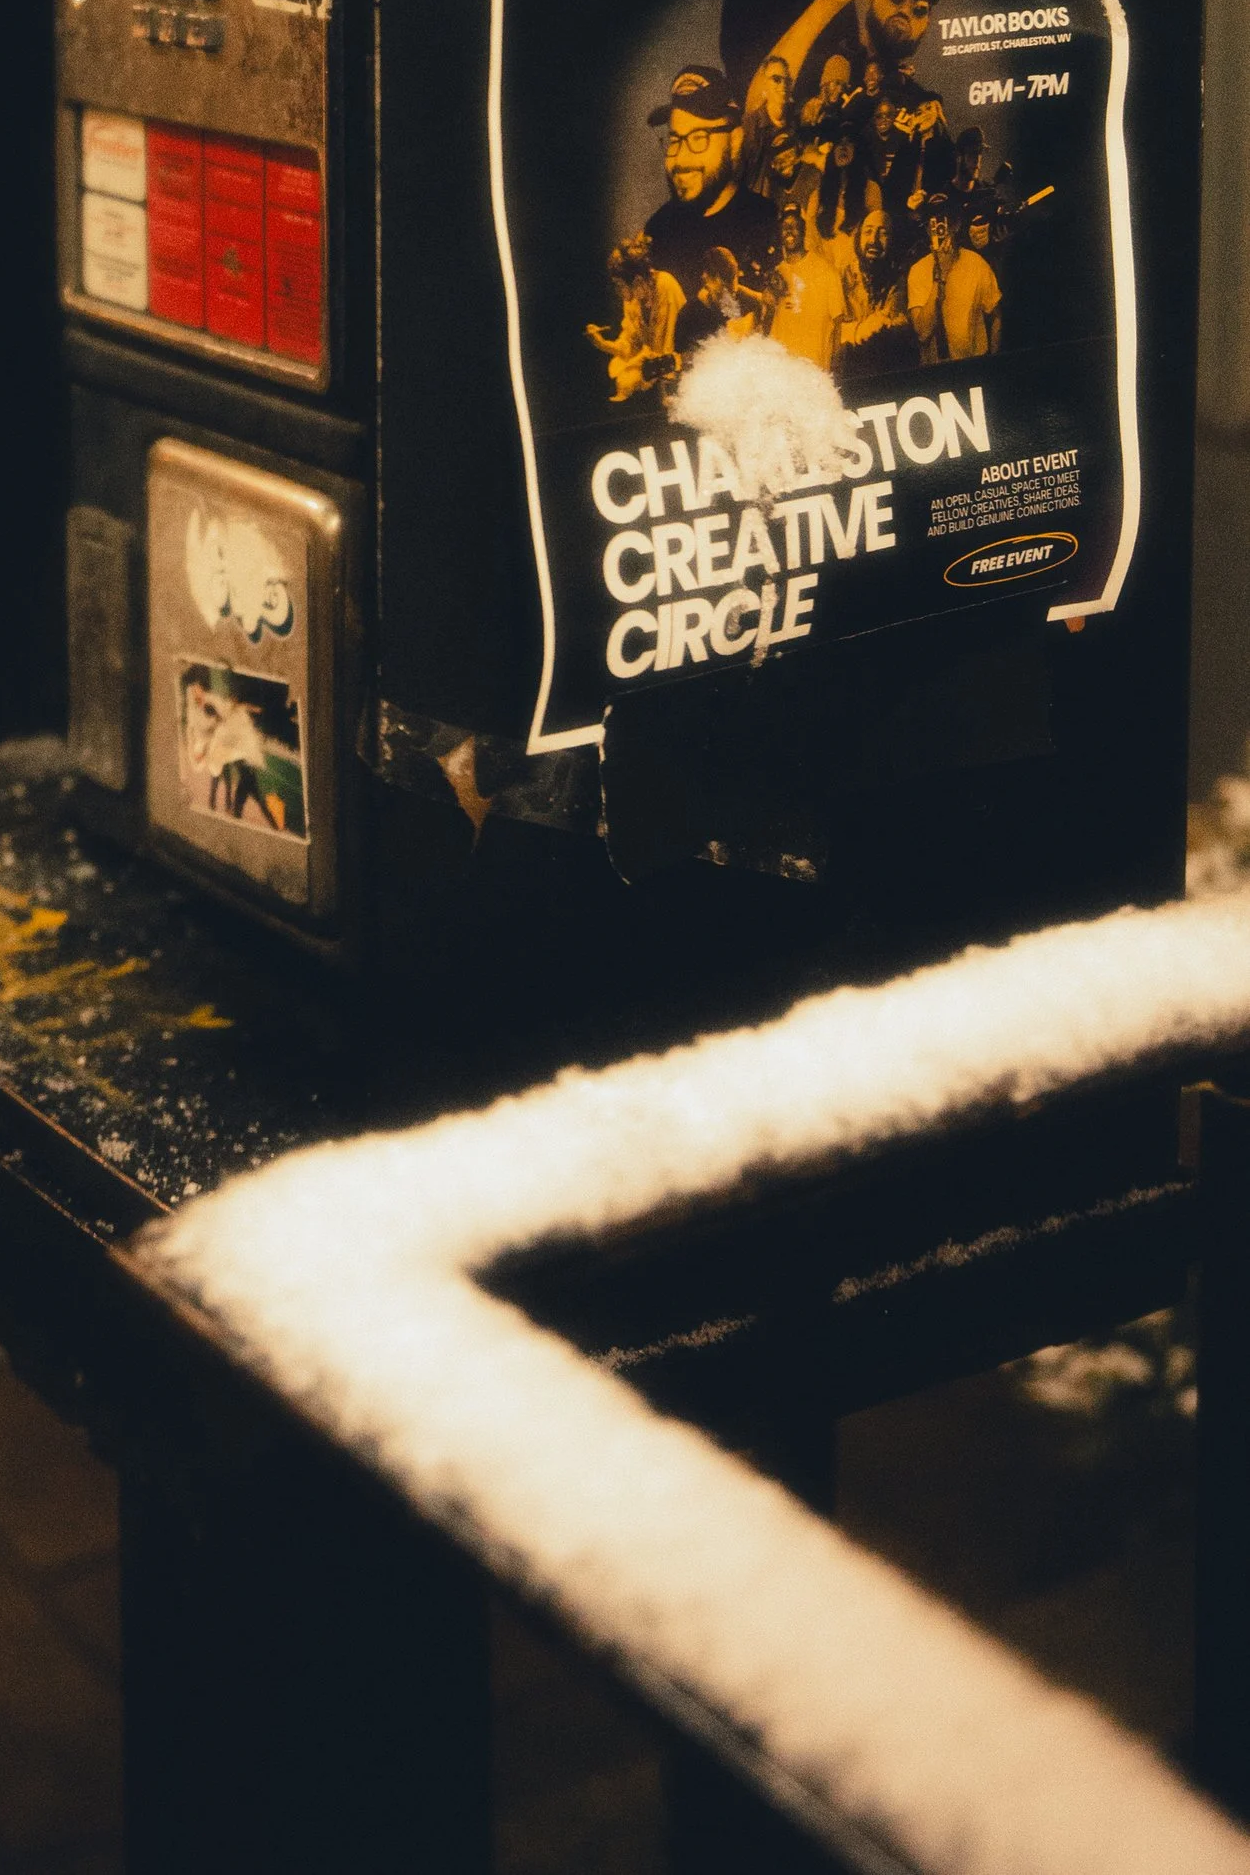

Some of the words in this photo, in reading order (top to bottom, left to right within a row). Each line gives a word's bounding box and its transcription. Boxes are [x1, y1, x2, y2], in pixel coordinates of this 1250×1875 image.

[938, 15, 1007, 40] TAYLOR
[1008, 6, 1071, 32] BOOKS
[957, 42, 990, 55] CAPITOL
[990, 40, 1002, 51] ST,
[1003, 34, 1056, 50] CHARLESTON,
[1057, 33, 1072, 44] WV
[969, 78, 1014, 106] 6PM
[1026, 72, 1070, 99] 7PM
[592, 386, 991, 524] CHALSTON
[981, 459, 1030, 485] ABOUT
[1033, 449, 1078, 474] EVENT
[930, 499, 944, 511] AN
[974, 488, 1010, 502] CASUAL
[1011, 478, 1041, 494] SPACE
[1042, 475, 1056, 487] TO
[1057, 470, 1081, 484] MEET
[931, 506, 969, 524] FELLOW
[1023, 489, 1053, 505] SHARE
[927, 524, 947, 538] AND
[948, 518, 975, 533] BUILD
[976, 509, 1015, 527] GENUINE
[1016, 495, 1082, 518] CONNECTIONS.
[603, 480, 897, 604] CREATIVE
[971, 555, 1005, 576] FREE
[1006, 544, 1054, 567] EVENT
[606, 572, 818, 679] CIRCLE
